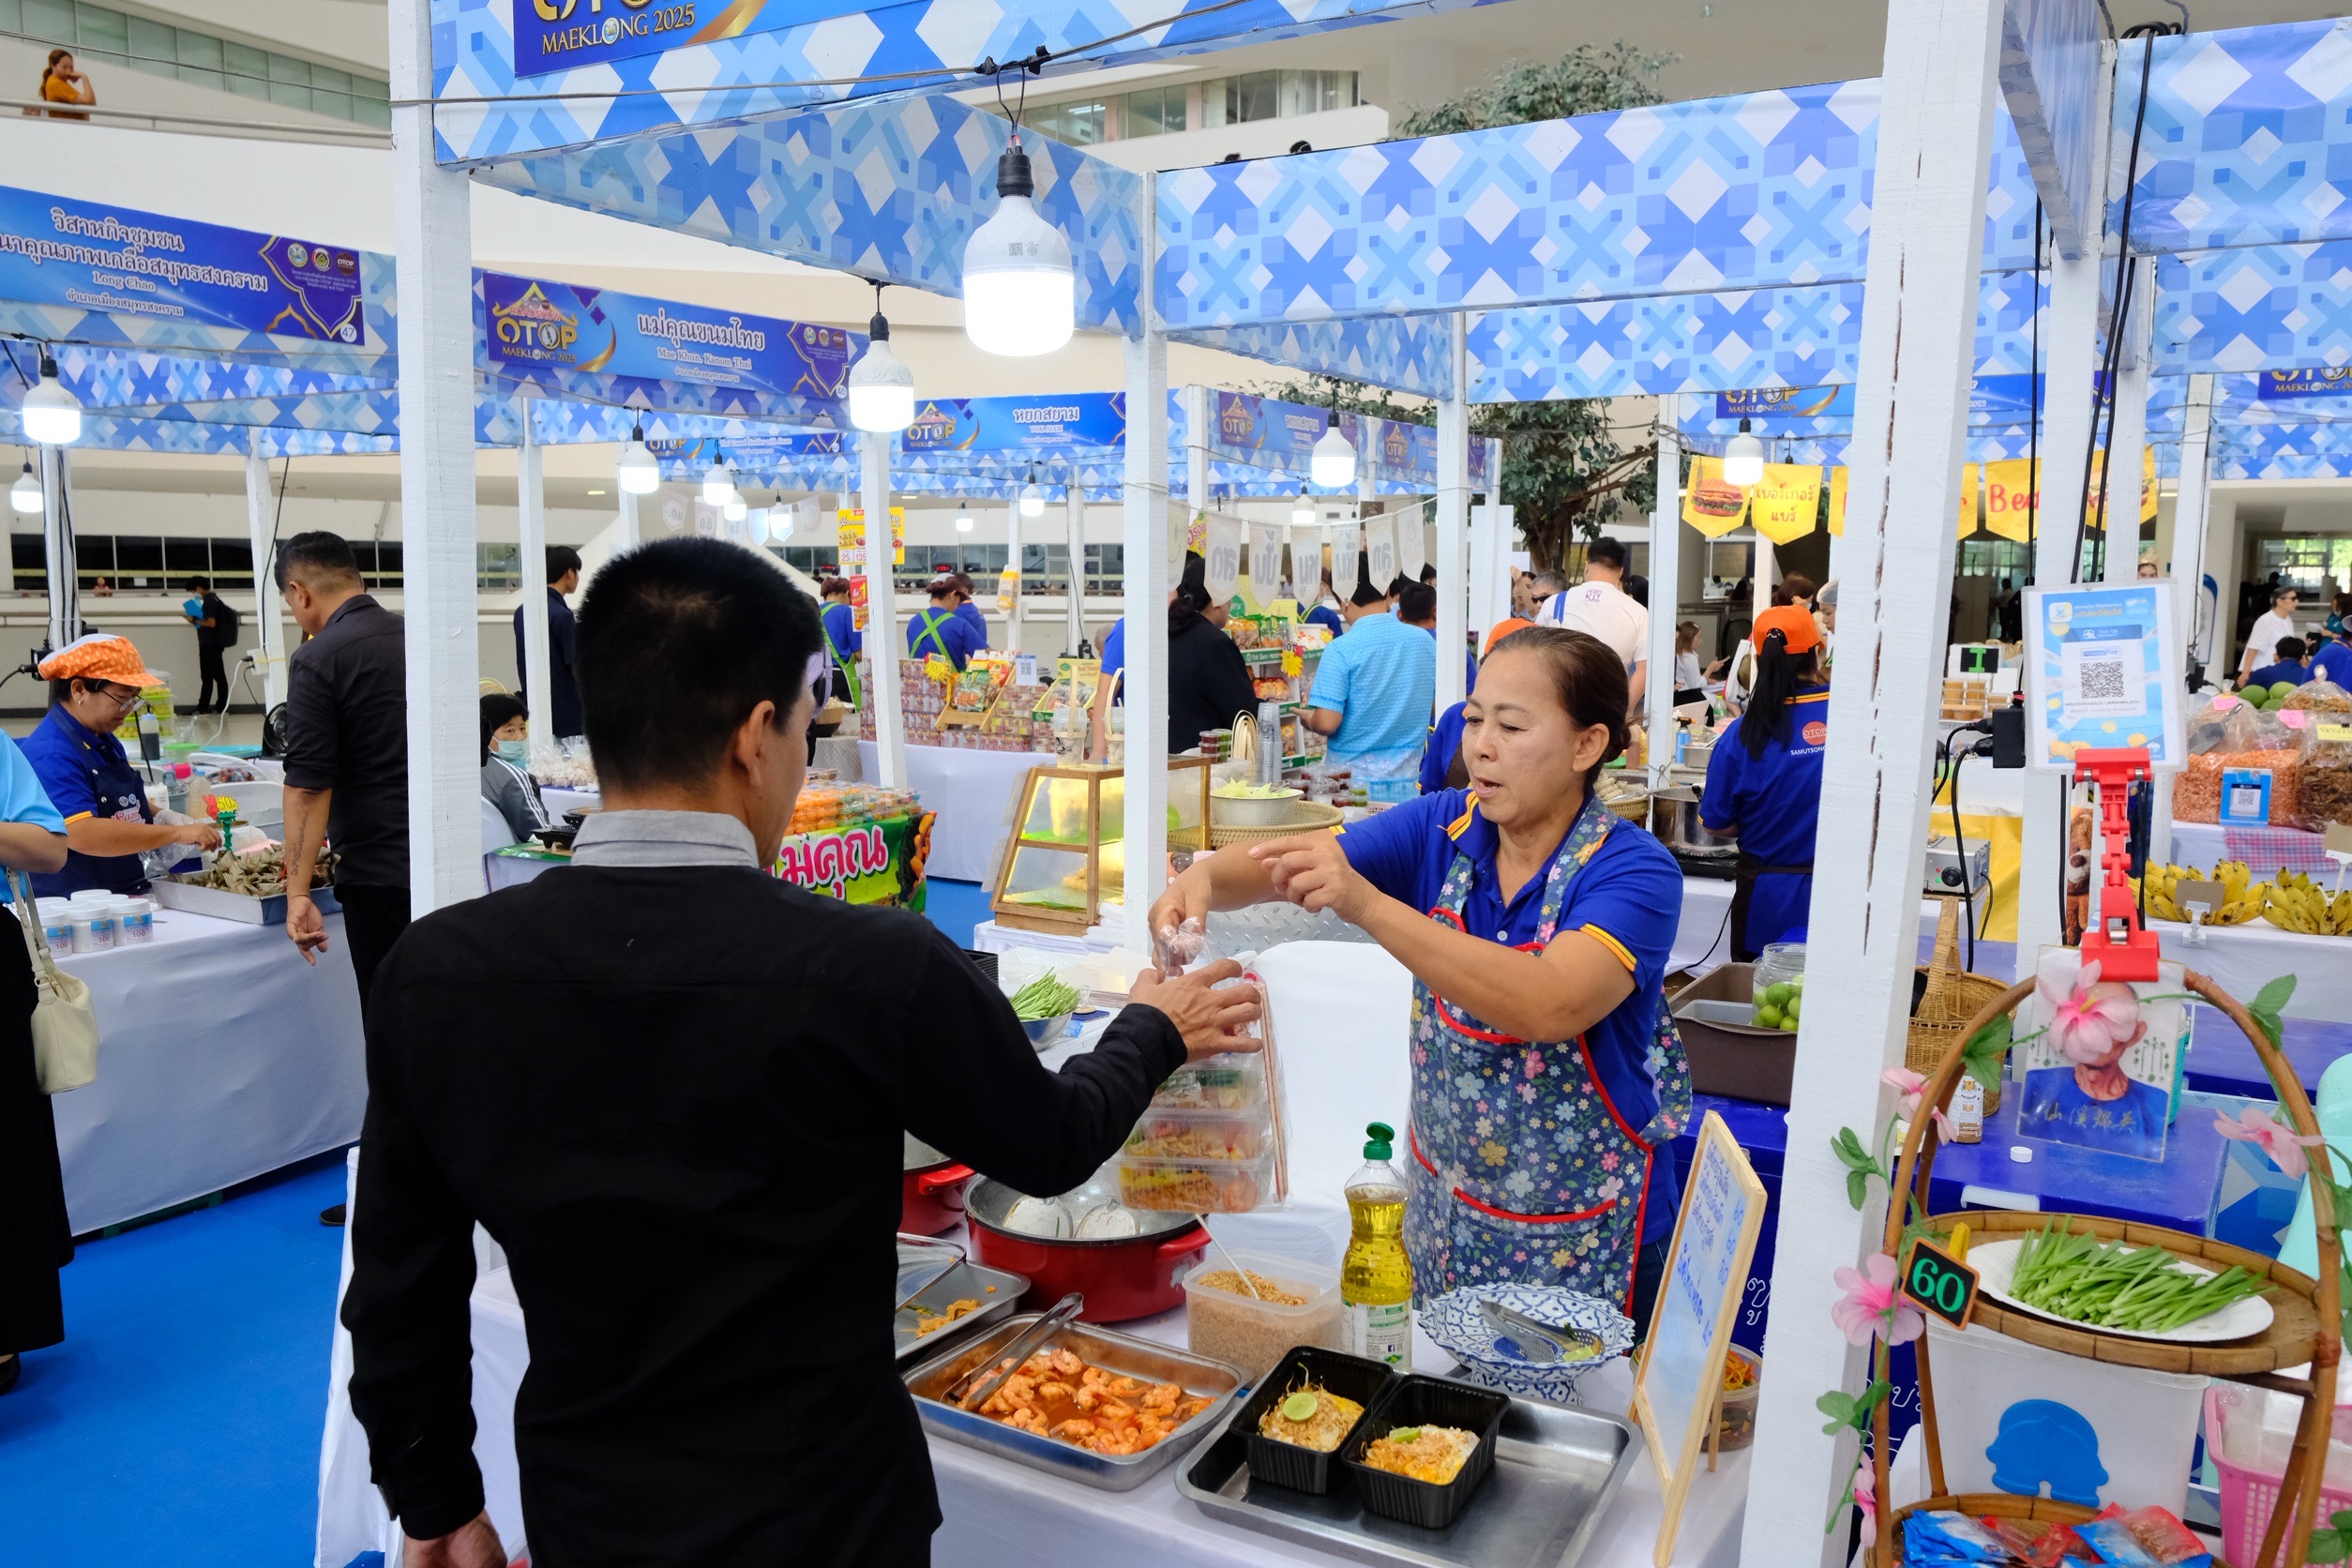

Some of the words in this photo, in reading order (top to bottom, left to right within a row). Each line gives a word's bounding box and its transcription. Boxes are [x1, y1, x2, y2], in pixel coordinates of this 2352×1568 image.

[541, 13, 648, 54] MAEKLONG
[653, 3, 695, 33] 2025
[51, 207, 184, 251] วิสาหกิจชุมชน
[93, 272, 125, 290] Long
[127, 277, 156, 292] Chao
[68, 289, 183, 315] อำเภอเมืองสมุทรสงคราม
[509, 307, 562, 322] ROADSHOW
[341, 327, 354, 338] 47
[496, 316, 578, 350] OTOP
[639, 309, 765, 350] แม่คุณขนมไทย
[503, 346, 555, 361] MAEKLONG
[557, 353, 577, 363] 2025
[657, 347, 675, 359] Mae
[704, 354, 732, 367] Kanom
[734, 357, 752, 369] Thai
[2275, 381, 2338, 392] MAEKLONG
[1014, 406, 1079, 423] หยกสยาม
[1728, 404, 1776, 414] MAEKLONG
[908, 424, 956, 440] OTOP
[1756, 483, 1817, 501] เบอร์เกอร์
[1989, 484, 2041, 512] Bea
[1772, 506, 1797, 522] แบร์
[1802, 728, 1827, 738] OTOP
[765, 828, 885, 897] มคุณ
[1911, 1257, 1966, 1313] 60
